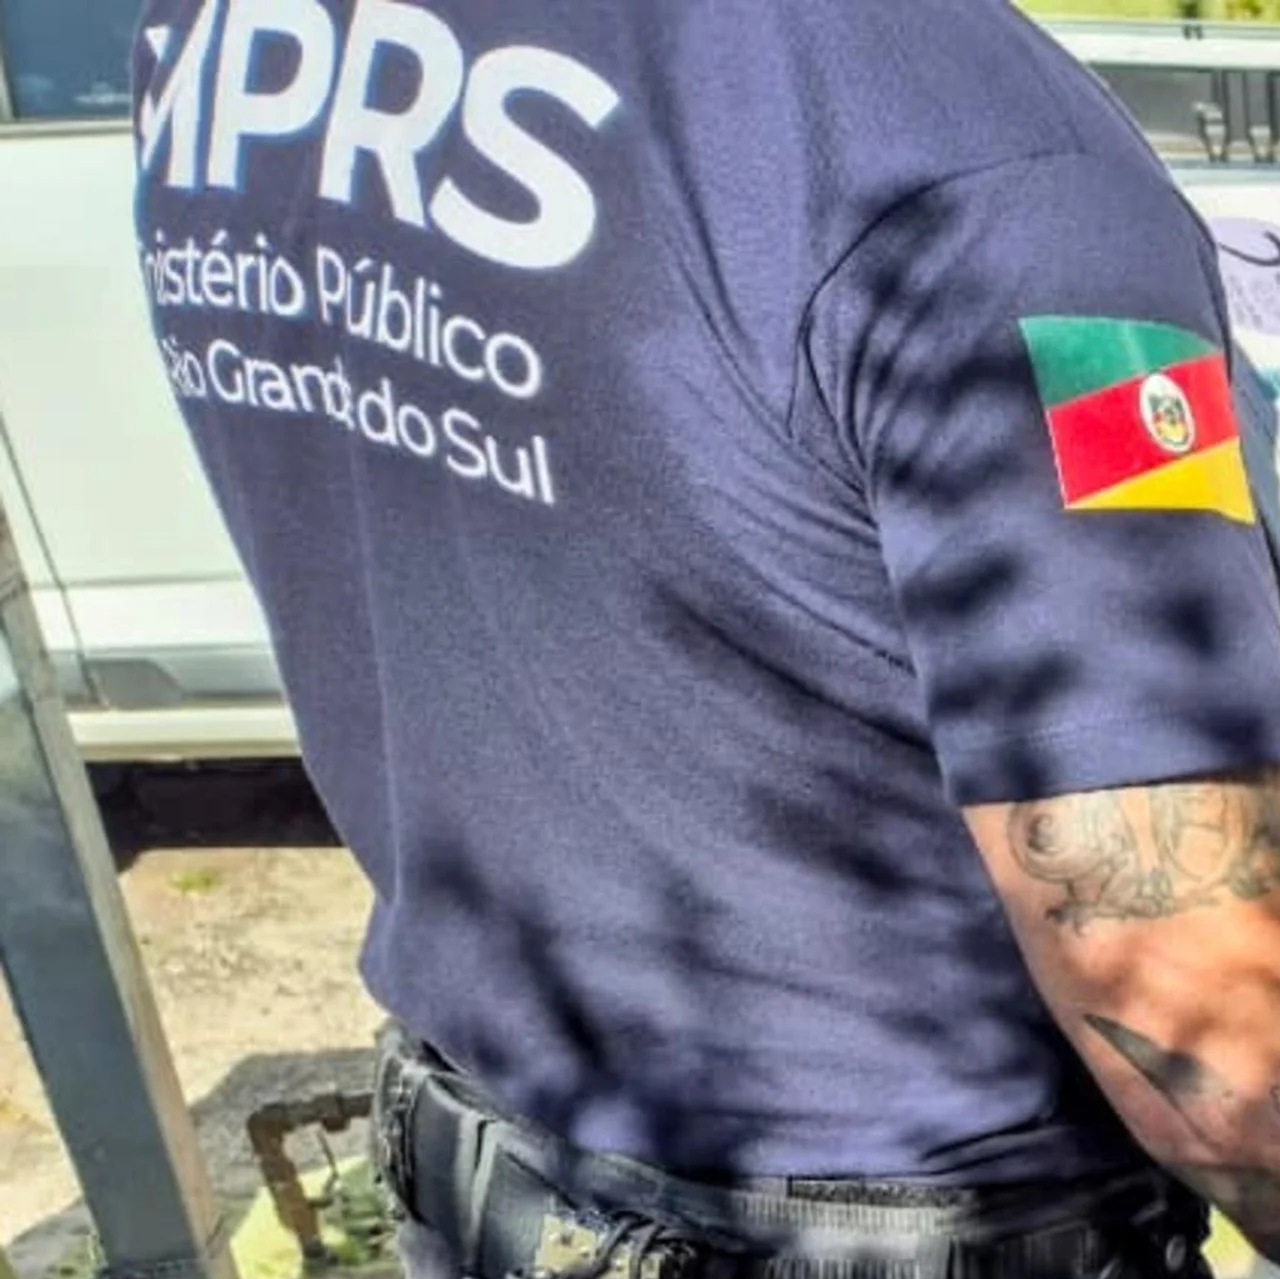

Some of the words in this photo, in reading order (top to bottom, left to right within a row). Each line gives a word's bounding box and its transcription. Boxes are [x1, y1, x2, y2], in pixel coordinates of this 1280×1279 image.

[316, 245, 543, 398] Público
[358, 378, 436, 457] do
[442, 408, 555, 504] Sul
